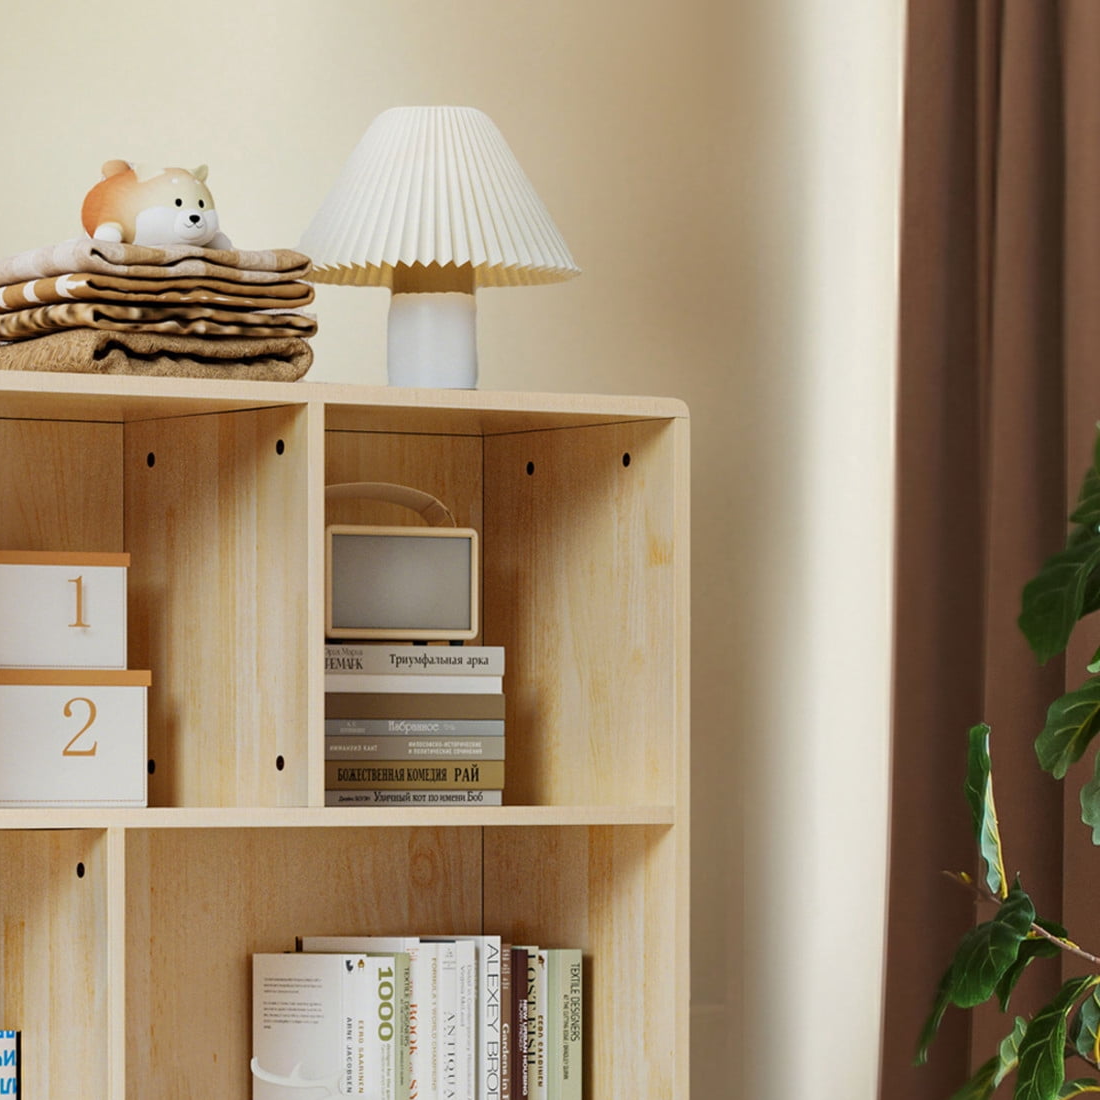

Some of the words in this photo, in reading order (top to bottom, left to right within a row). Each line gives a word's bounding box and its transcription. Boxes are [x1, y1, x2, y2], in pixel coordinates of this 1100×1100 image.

[67, 575, 91, 628] 1
[389, 653, 463, 668] Триумфальная
[466, 655, 490, 668] арка
[62, 697, 98, 756] 2
[388, 719, 440, 735] Избранное
[337, 767, 405, 782] БОЖЕСТВЕННАЯ
[406, 767, 448, 782] КОМЕДИЯ
[454, 764, 480, 782] РАЙ
[373, 791, 411, 803] Уличный
[412, 793, 426, 802] кот
[428, 793, 439, 802] по
[440, 793, 466, 802] имени
[467, 790, 484, 802] Боб
[487, 944, 499, 1033] ALEXEY
[570, 963, 580, 994] TEXTILE
[377, 966, 394, 1042] 1000
[570, 997, 580, 1042] DESIGNERS
[501, 1023, 509, 1075] Gardens
[502, 1078, 509, 1090] in
